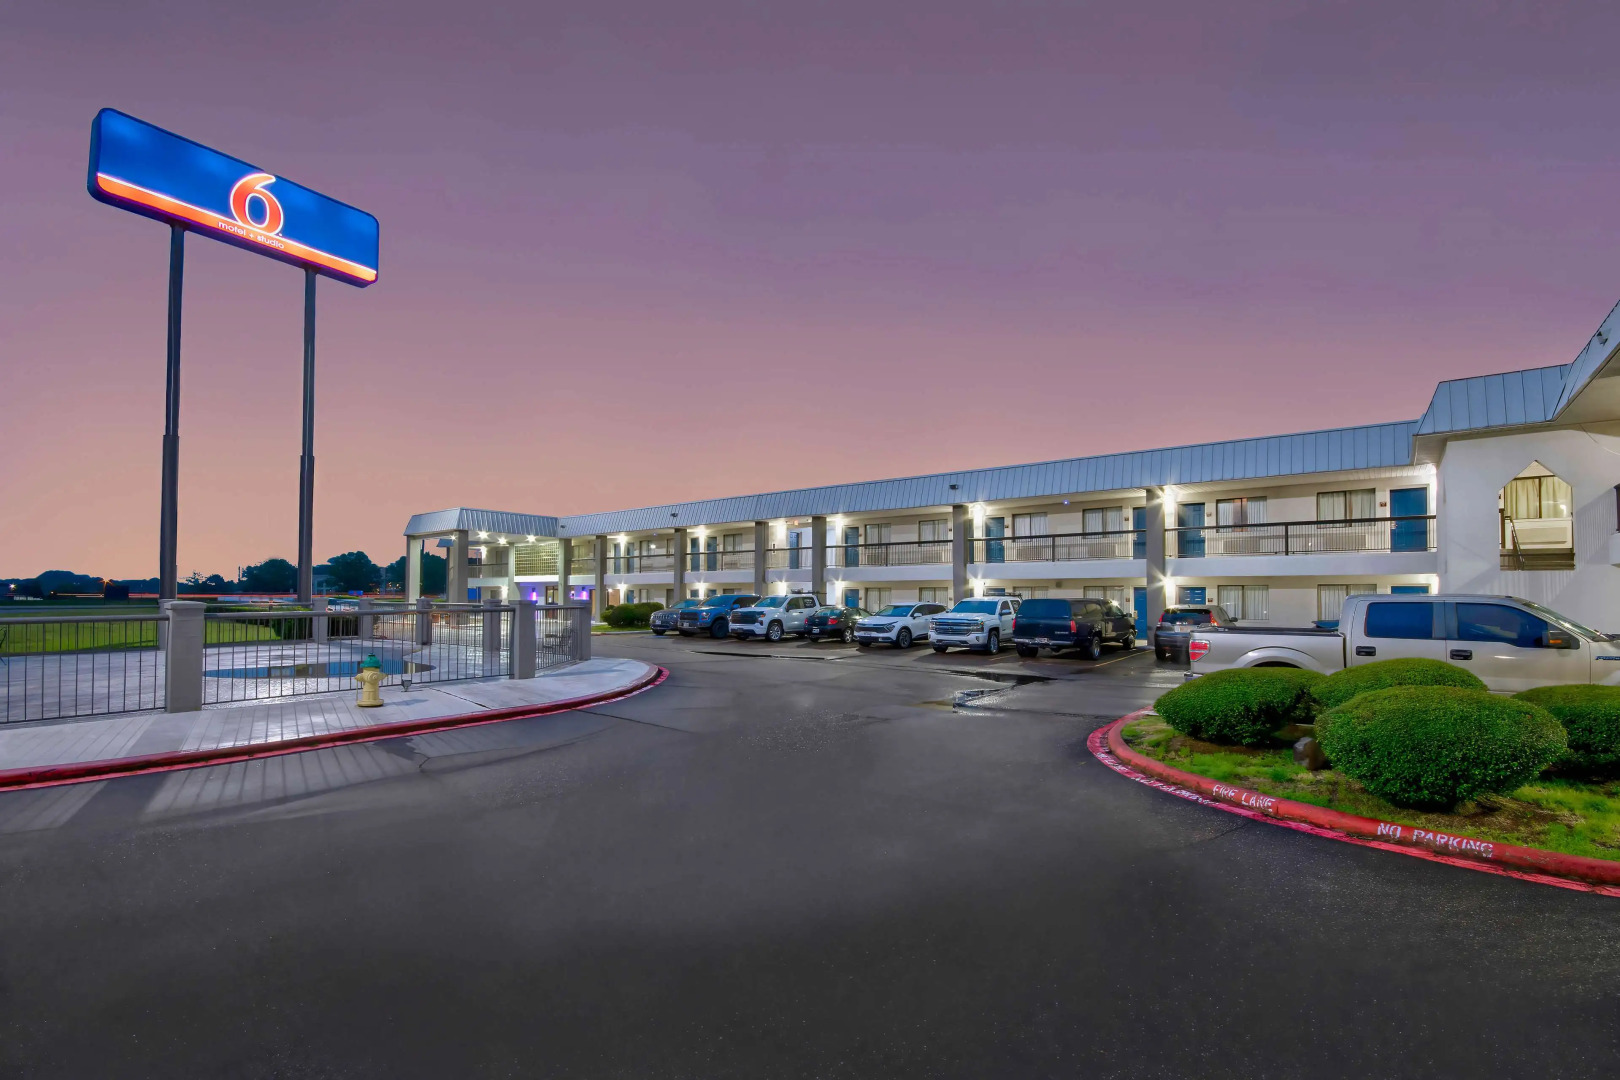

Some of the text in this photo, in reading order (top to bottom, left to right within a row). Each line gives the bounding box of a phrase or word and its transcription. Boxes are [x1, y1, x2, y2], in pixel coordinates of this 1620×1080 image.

[229, 173, 284, 235] 6
[218, 221, 247, 236] motel
[256, 235, 285, 249] studio
[1212, 784, 1238, 801] FIRE
[1241, 792, 1276, 812] LANE
[1377, 822, 1494, 858] NO PARKING
